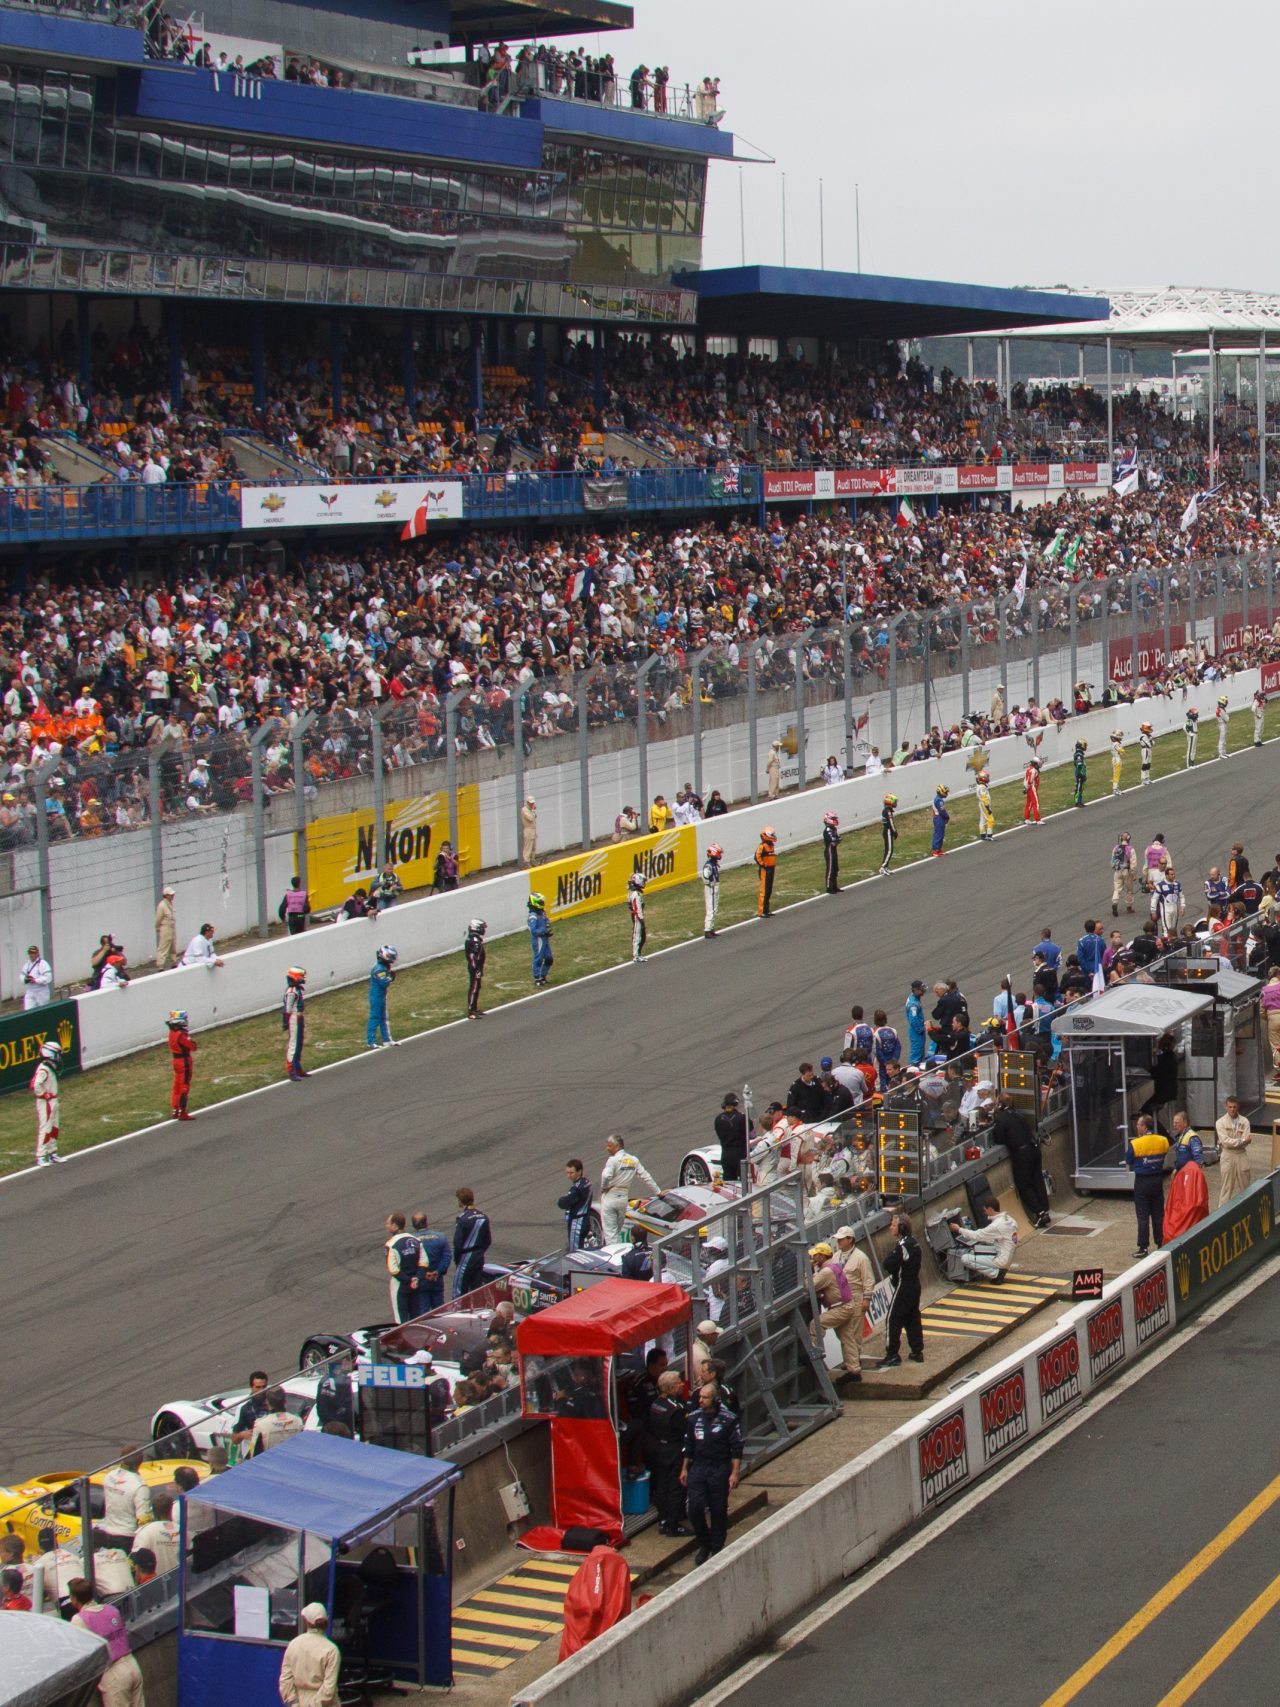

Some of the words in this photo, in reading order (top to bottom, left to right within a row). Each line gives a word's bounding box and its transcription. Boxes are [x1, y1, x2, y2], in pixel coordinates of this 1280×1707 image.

[768, 480, 782, 492] Audi
[782, 481, 793, 492] TDI
[794, 481, 813, 492] Power
[836, 479, 850, 490] Audi
[850, 478, 861, 489] TDI
[960, 474, 970, 484] Audi
[971, 474, 980, 484] TDI
[981, 474, 996, 484] Power
[1014, 472, 1025, 482] Audi
[1034, 472, 1048, 482] Power
[1066, 472, 1074, 481] Audi
[1084, 471, 1096, 480] Power
[1114, 656, 1133, 678] Aud
[1264, 672, 1276, 690] Audi
[355, 820, 431, 874] Nkon
[634, 849, 674, 879] Nikon
[558, 870, 602, 906] Nikon
[0, 1031, 48, 1070] OLEX
[1200, 1215, 1254, 1284] ROLEX
[1075, 1273, 1102, 1286] AMR
[512, 1287, 528, 1309] 60
[1134, 1269, 1167, 1322] MOTO
[1087, 1302, 1122, 1358] MOTO
[358, 1365, 424, 1387] FELB
[1038, 1336, 1080, 1394] MOTO
[980, 1372, 1026, 1436] MOTO
[919, 1413, 966, 1480] MOTO
